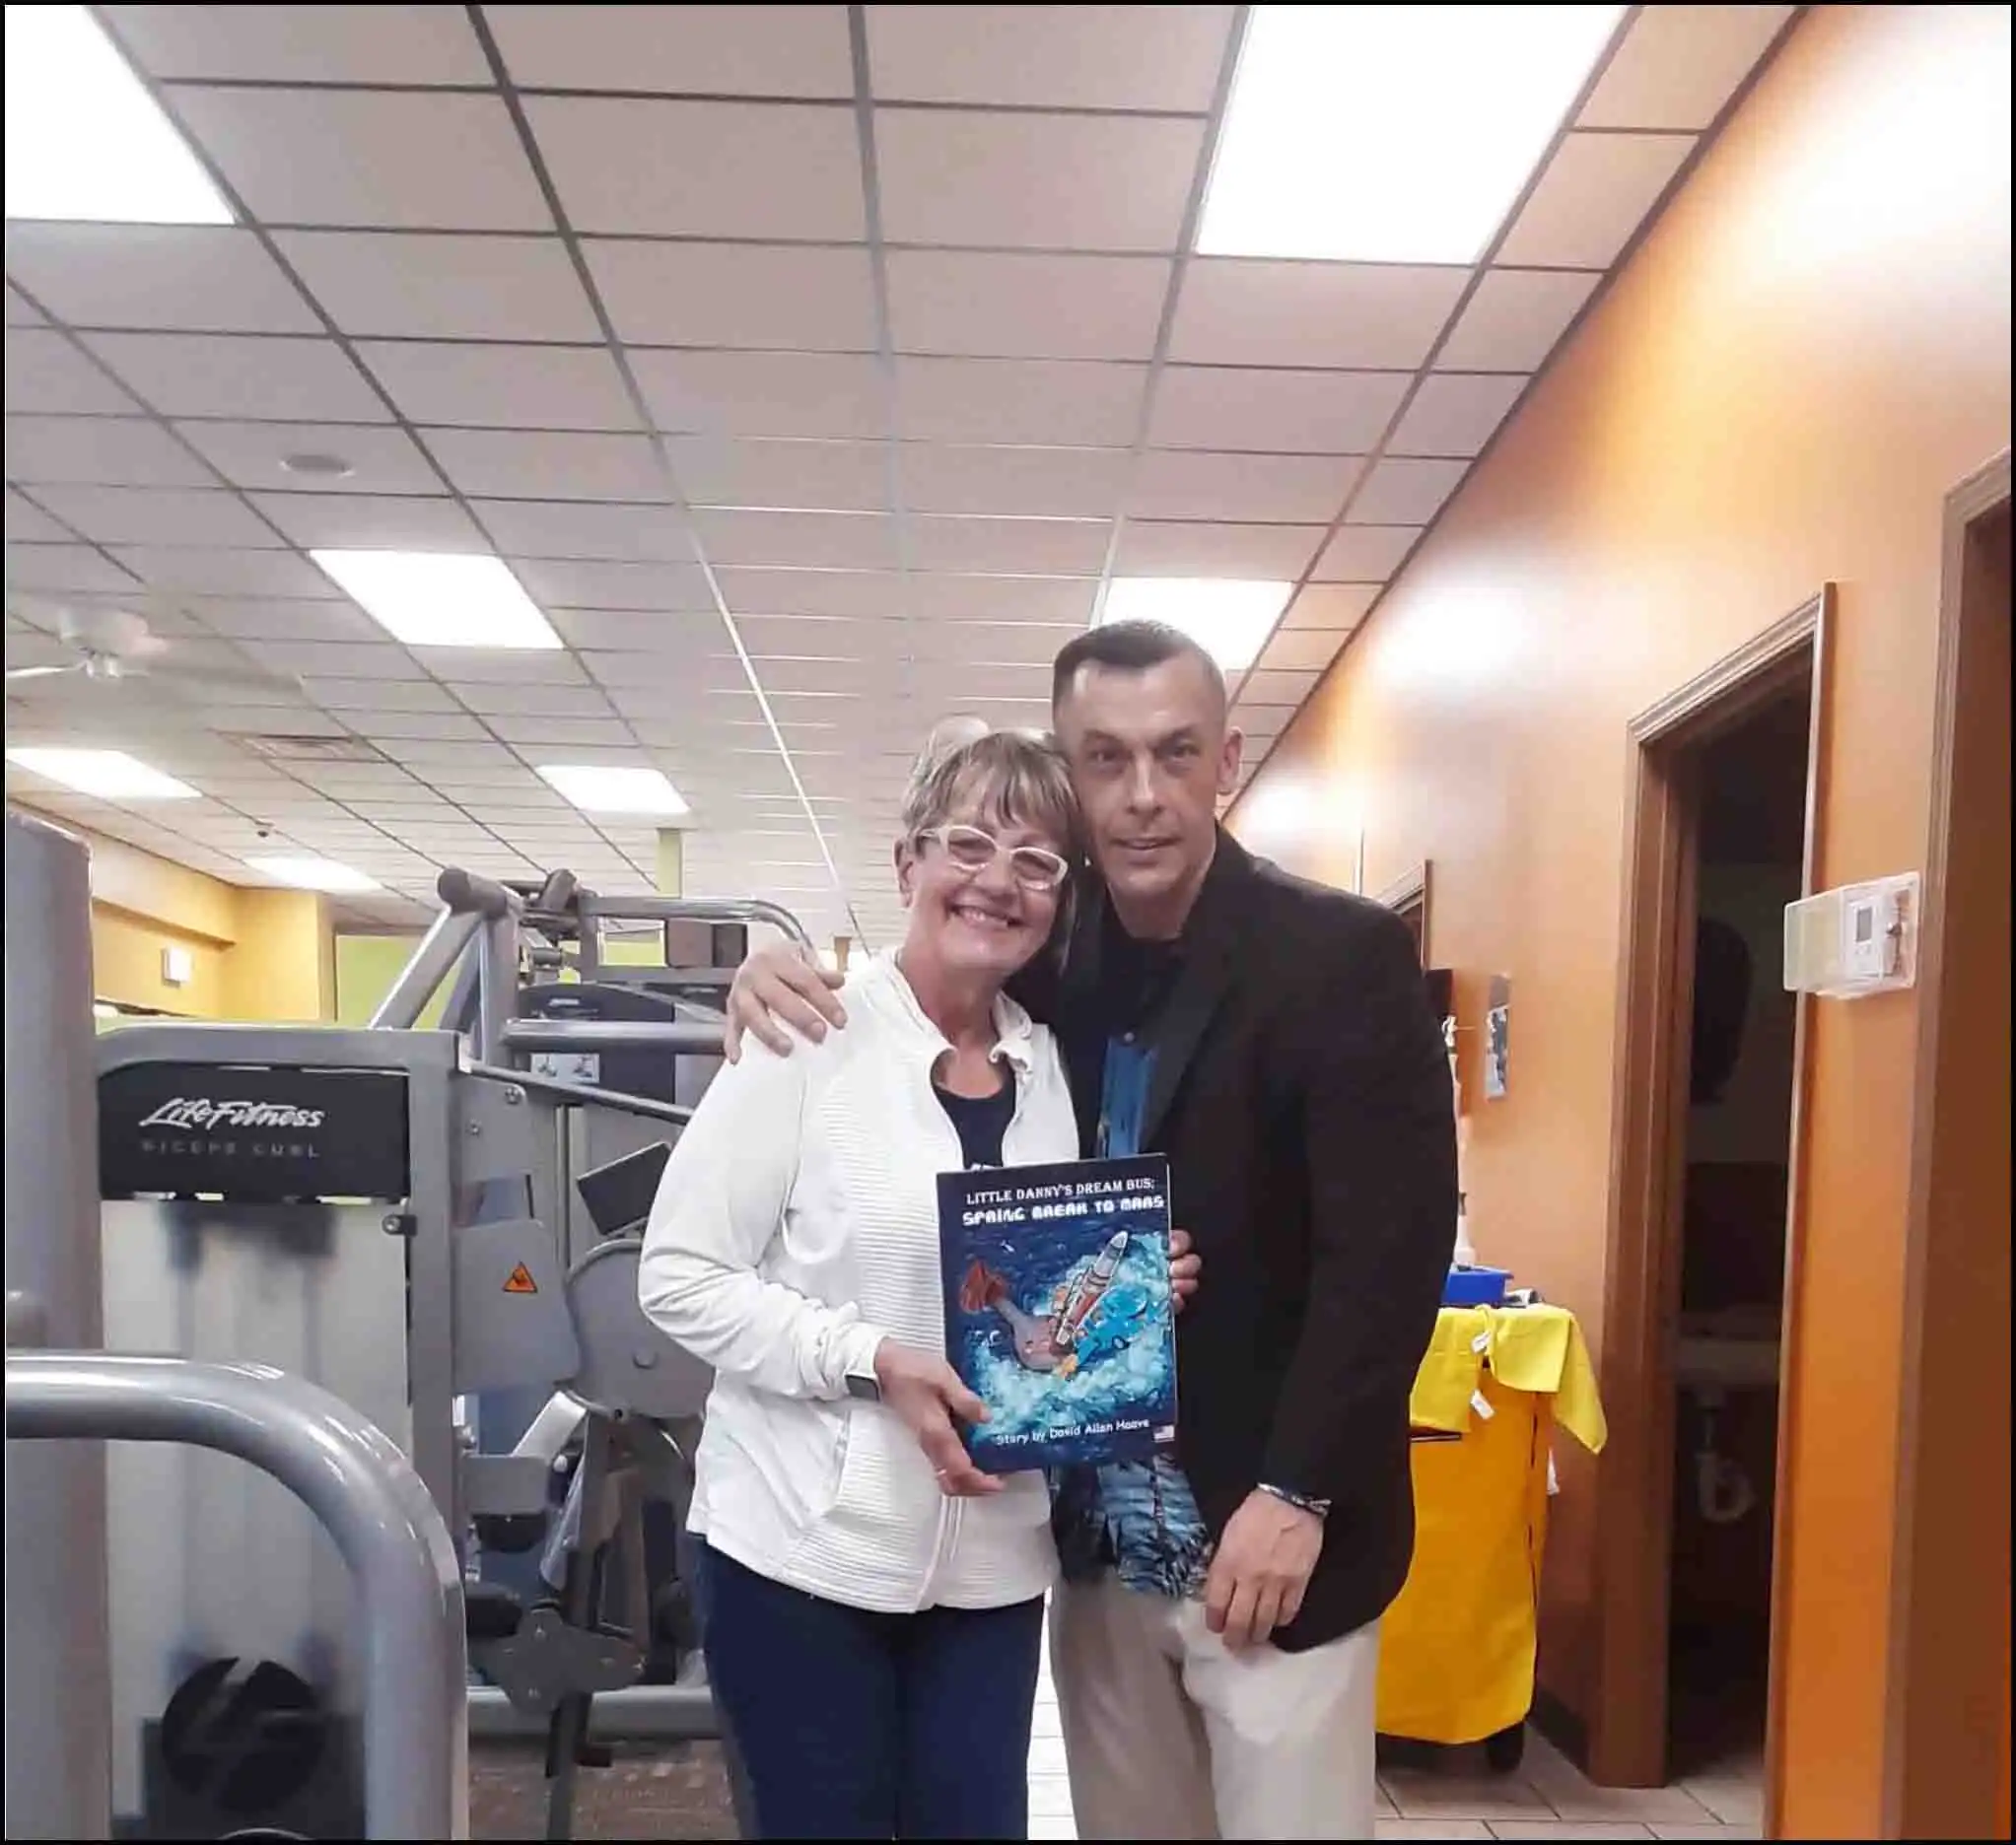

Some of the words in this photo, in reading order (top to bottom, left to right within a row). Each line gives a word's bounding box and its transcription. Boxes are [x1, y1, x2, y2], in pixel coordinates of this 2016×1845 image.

[966, 1191, 1012, 1205] LITTLE
[1016, 1183, 1073, 1200] DANNY'S
[1077, 1180, 1123, 1196] DREAM
[962, 1207, 1026, 1226] SPRING
[1031, 1200, 1088, 1221] BREAK
[1093, 1198, 1115, 1214] TO
[1120, 1194, 1165, 1211] MARS
[995, 1433, 1029, 1446] Story
[1050, 1425, 1081, 1439] David
